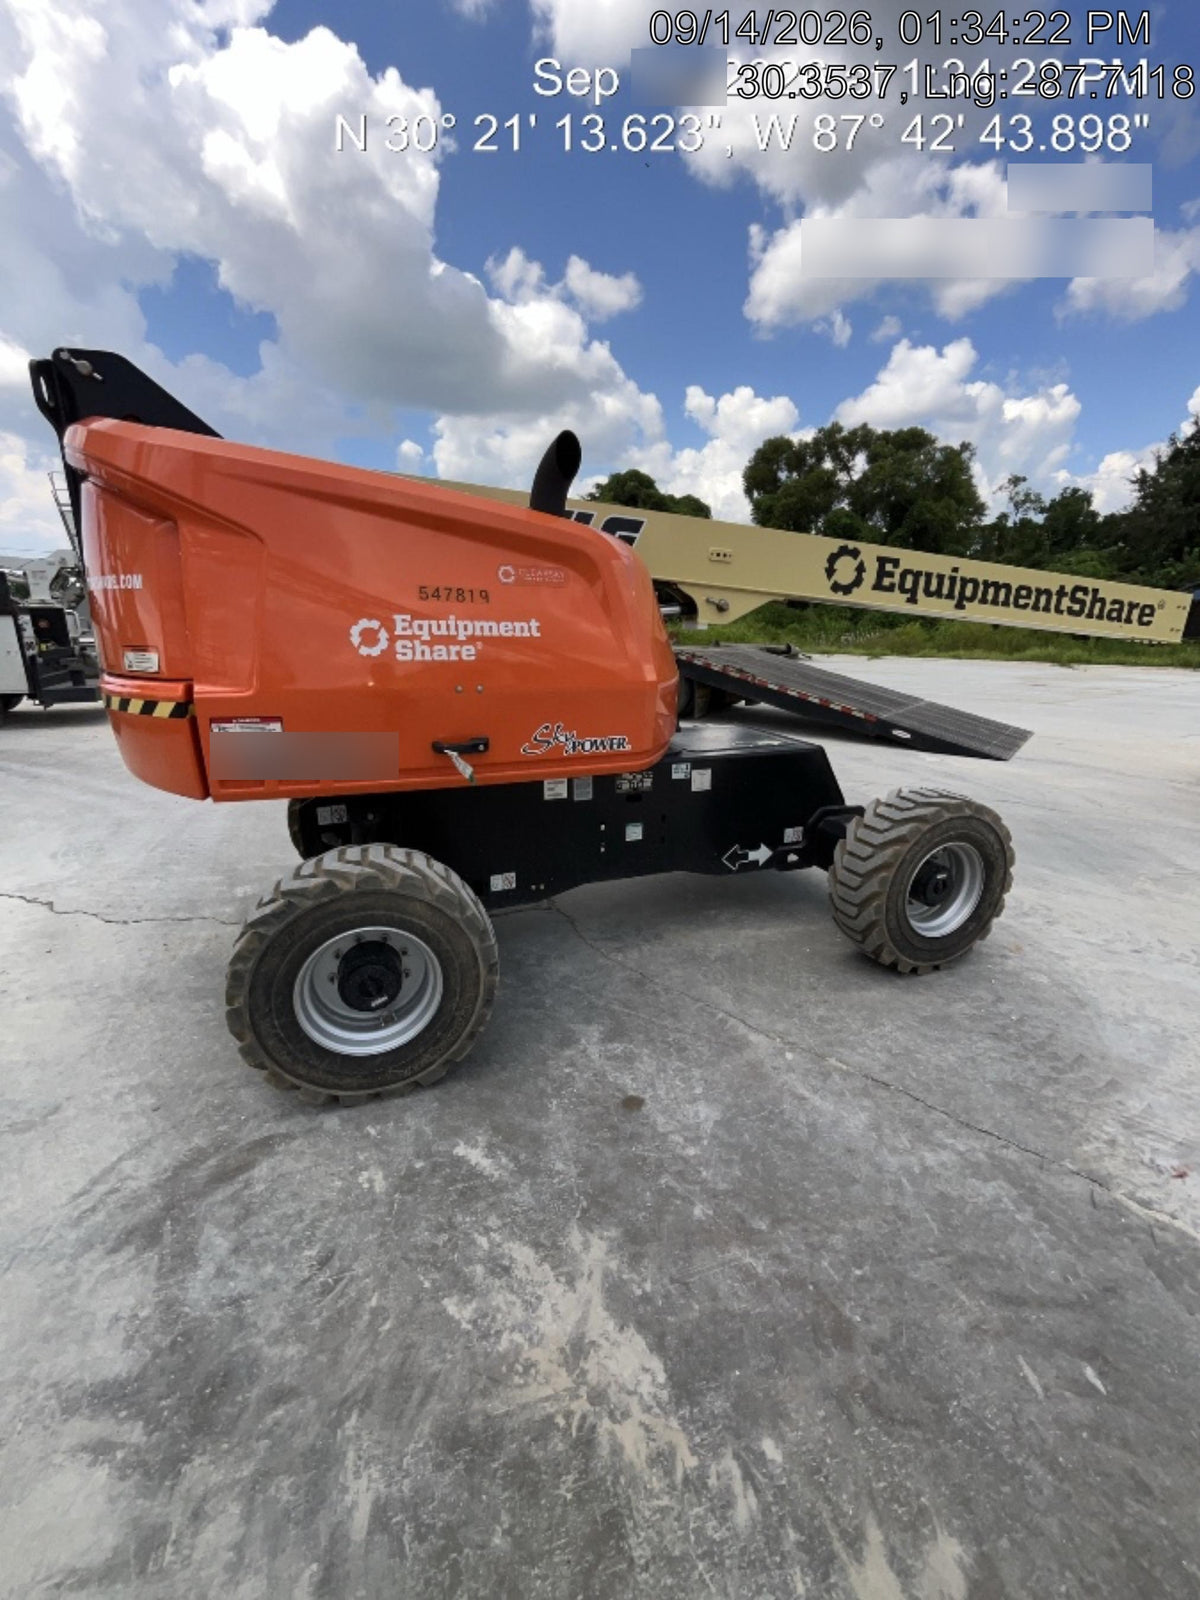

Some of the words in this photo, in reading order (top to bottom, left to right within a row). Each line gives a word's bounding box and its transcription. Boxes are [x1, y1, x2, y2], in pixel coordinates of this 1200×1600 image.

[418, 586, 490, 604] 547819
[872, 555, 1157, 627] EquipmentShare
[393, 614, 542, 641] Equipment
